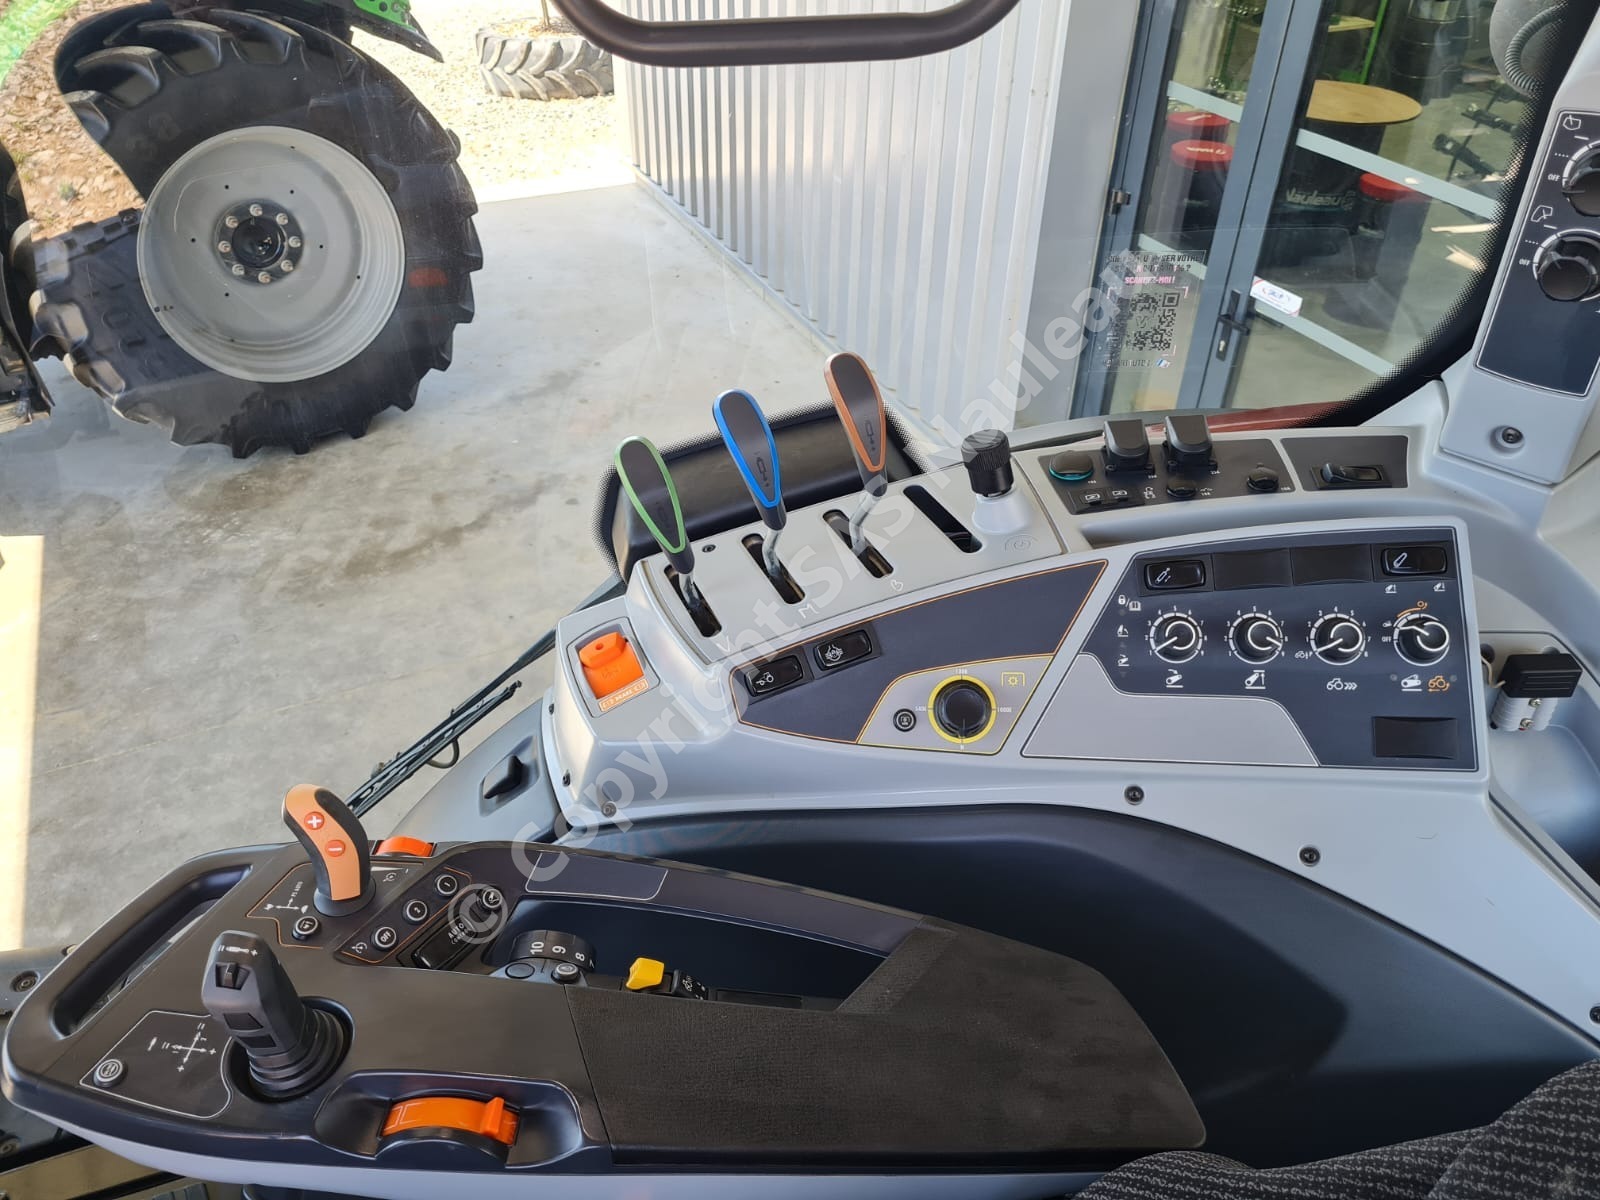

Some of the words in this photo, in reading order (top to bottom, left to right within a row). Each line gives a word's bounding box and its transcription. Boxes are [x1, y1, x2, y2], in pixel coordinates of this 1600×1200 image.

[1547, 173, 1560, 182] OFF
[448, 922, 465, 938] AUTO
[380, 932, 391, 943] OFF
[530, 941, 545, 955] 10
[552, 945, 566, 955] 9
[575, 952, 585, 962] 8
